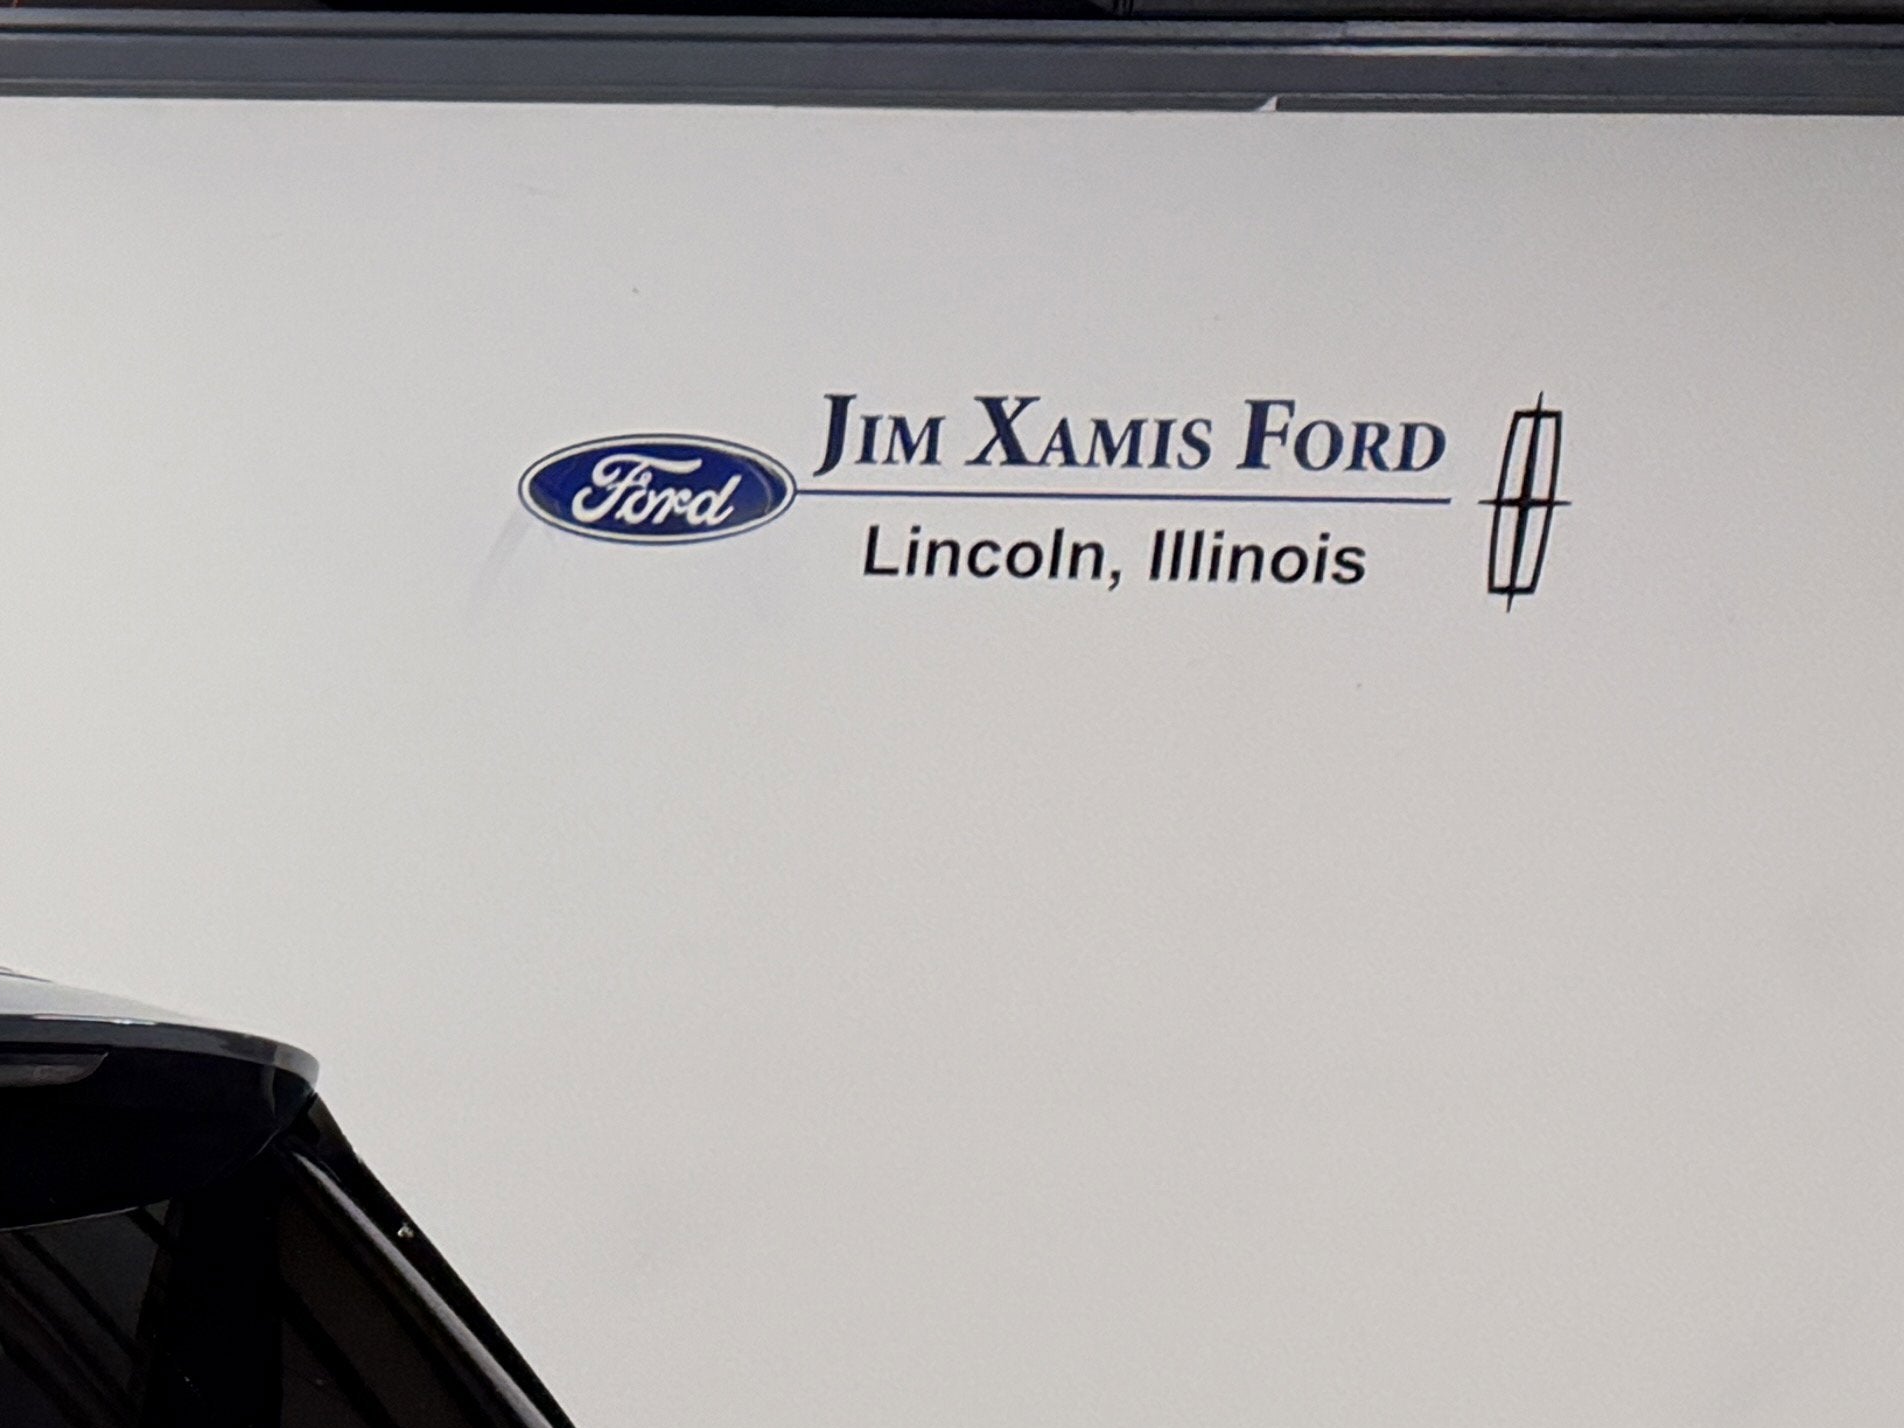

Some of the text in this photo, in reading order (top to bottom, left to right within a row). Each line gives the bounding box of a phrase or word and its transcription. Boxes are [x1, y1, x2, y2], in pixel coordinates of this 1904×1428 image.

[814, 393, 1446, 478] JIM XAMIS FORD
[572, 452, 735, 527] Ford
[863, 525, 1367, 590] Lincoln, Illinois
